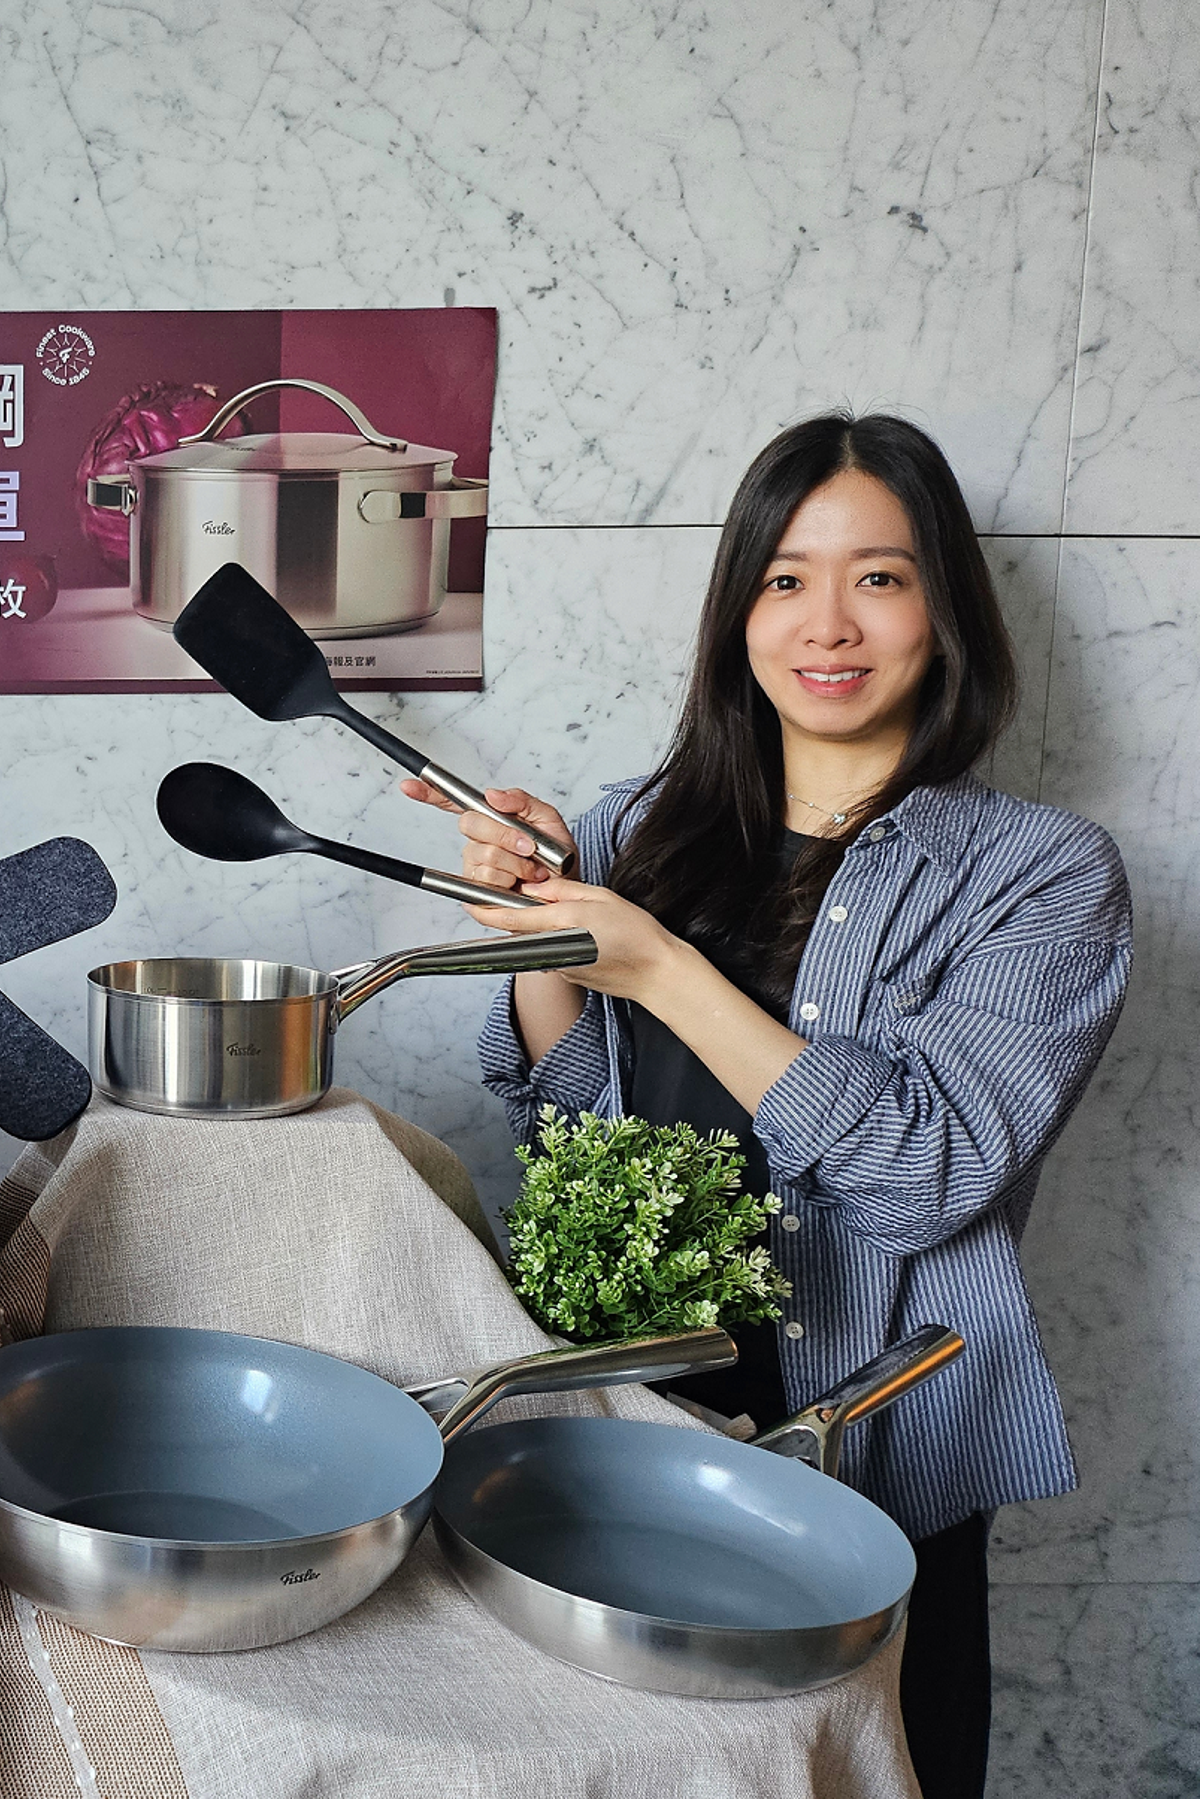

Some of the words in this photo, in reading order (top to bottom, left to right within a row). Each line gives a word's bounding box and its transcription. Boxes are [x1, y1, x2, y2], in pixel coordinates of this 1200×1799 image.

[202, 520, 236, 535] Fissler
[226, 1041, 262, 1057] Fissler
[280, 1567, 321, 1586] Fissler
